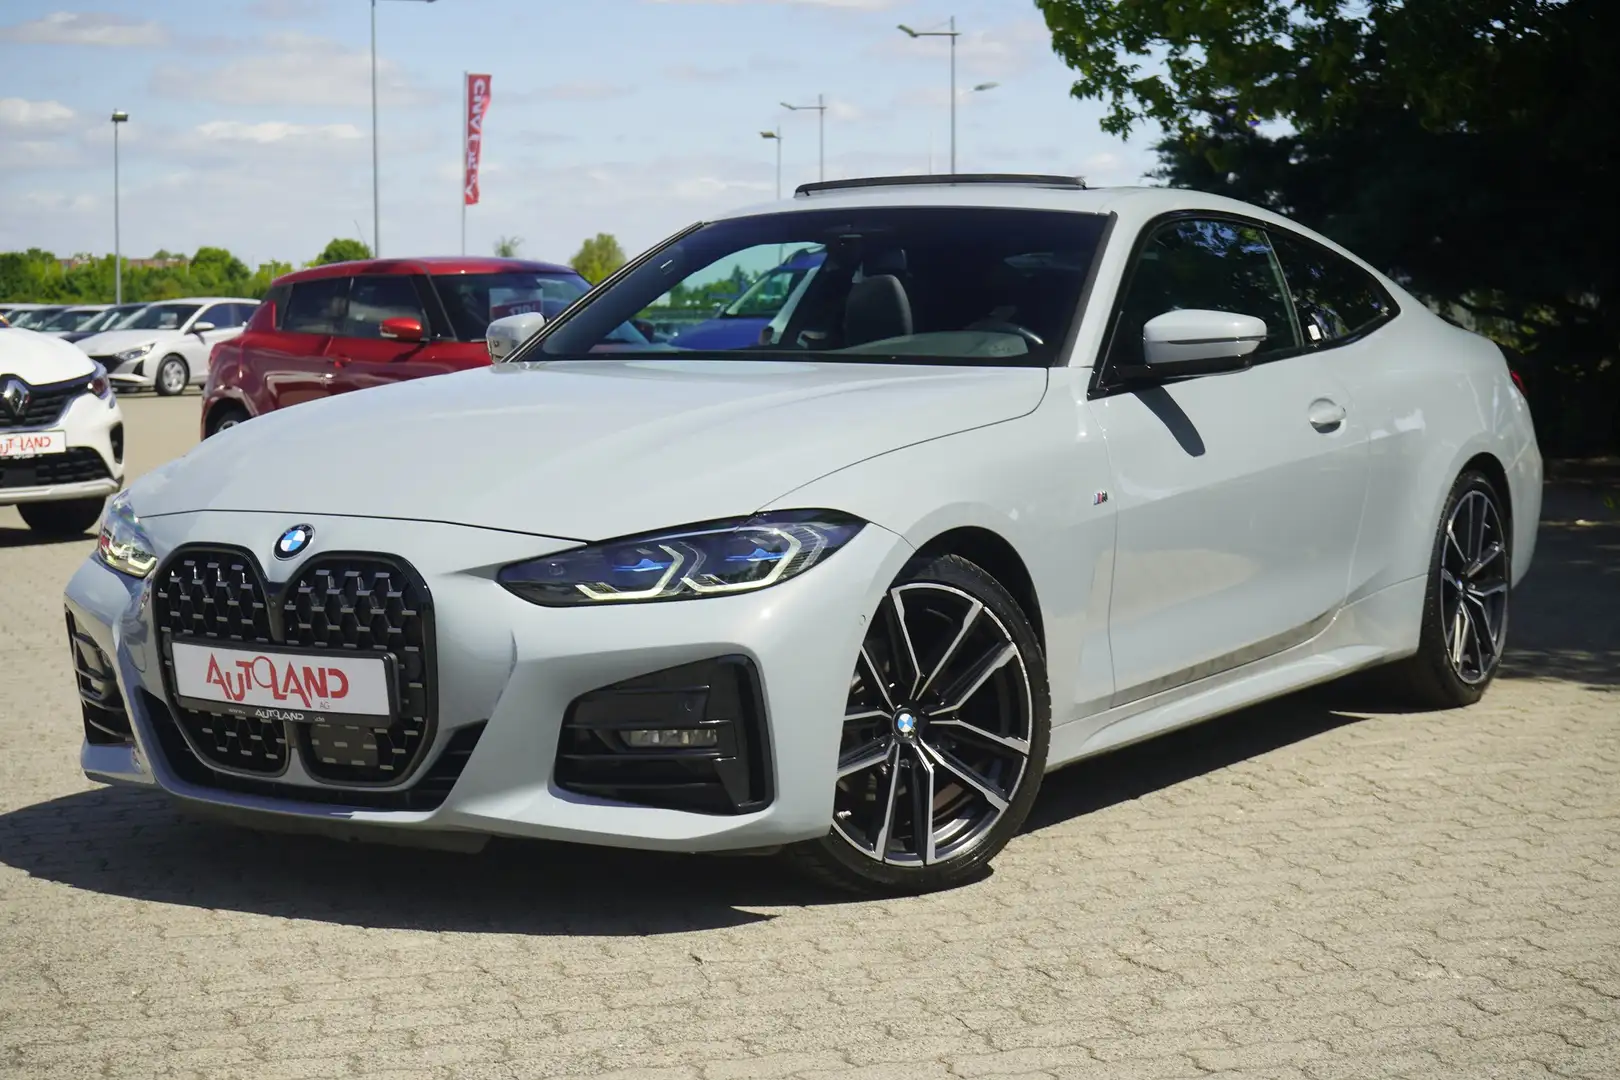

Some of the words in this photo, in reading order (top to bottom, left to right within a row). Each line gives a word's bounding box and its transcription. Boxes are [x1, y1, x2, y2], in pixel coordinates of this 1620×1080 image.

[206, 652, 349, 708] AUTOLAND
[319, 701, 330, 710] AG
[255, 708, 304, 721] AUTOLAND
